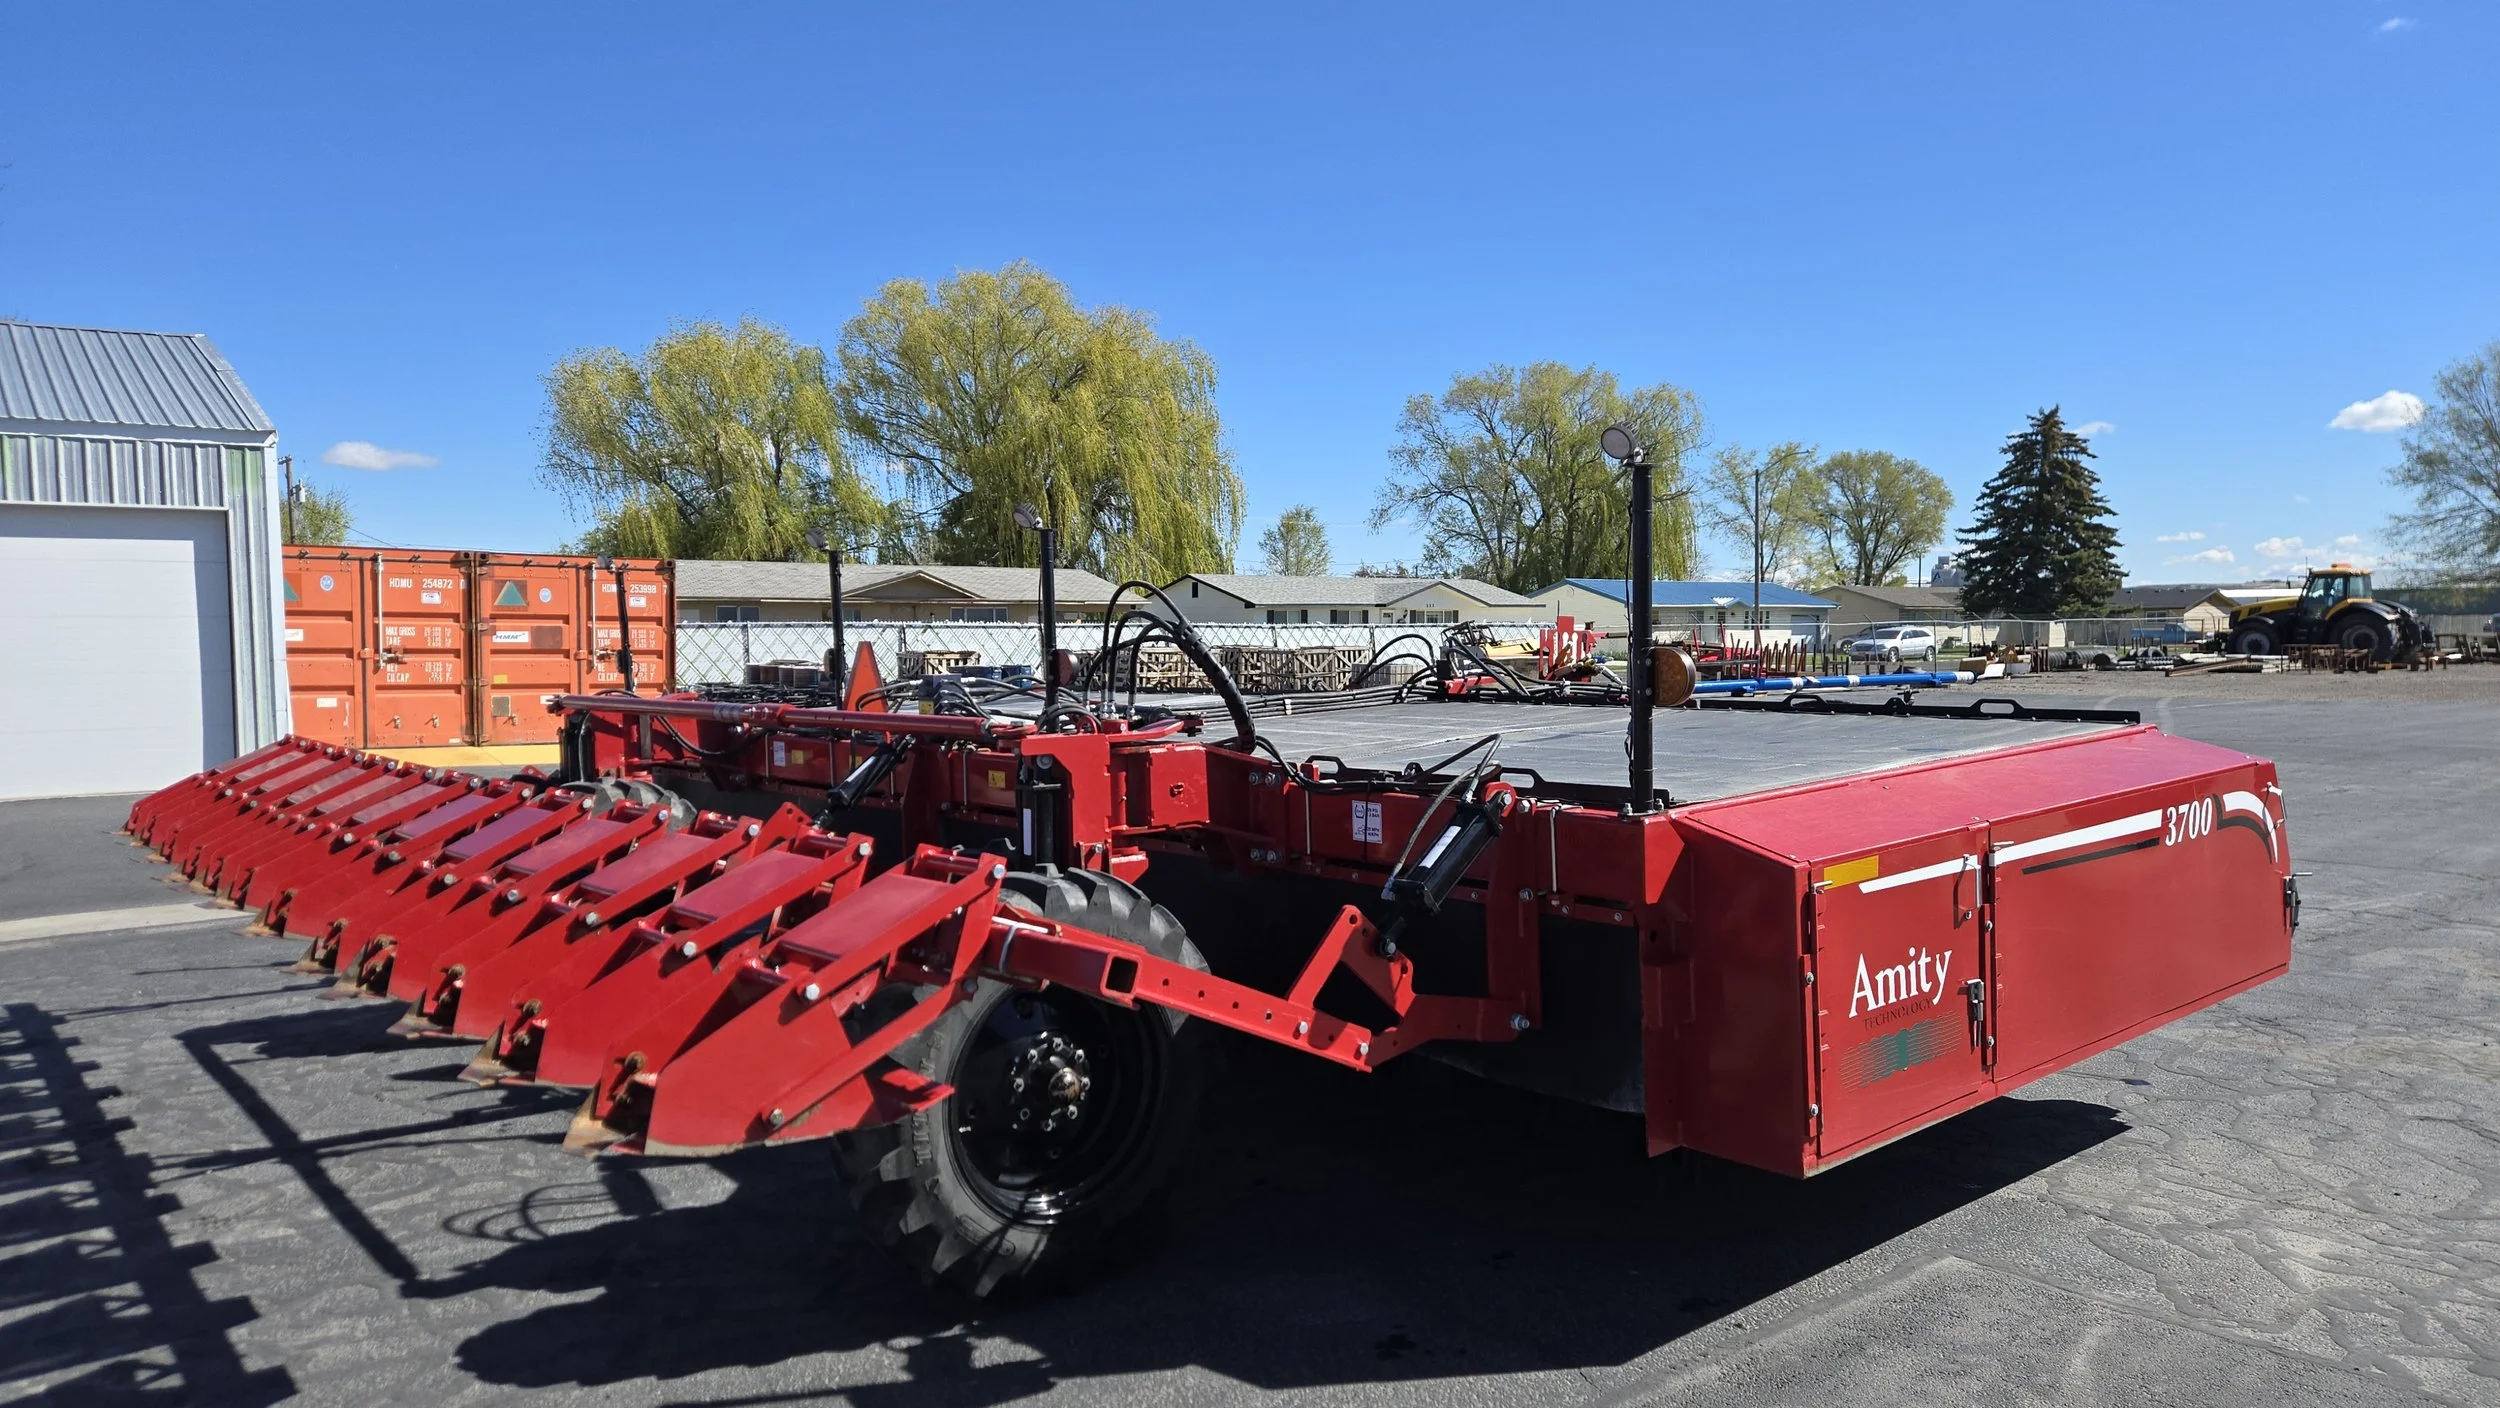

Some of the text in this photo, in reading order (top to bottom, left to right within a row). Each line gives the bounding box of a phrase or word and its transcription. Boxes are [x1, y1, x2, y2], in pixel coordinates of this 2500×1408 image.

[422, 578, 454, 589] 254872
[601, 583, 618, 593] HDM
[398, 626, 416, 637] GROSS
[609, 629, 621, 638] GROS
[2165, 797, 2213, 847] 3700
[1849, 946, 1953, 1019] Amity
[1863, 997, 1932, 1031] TECHNOLOGY
